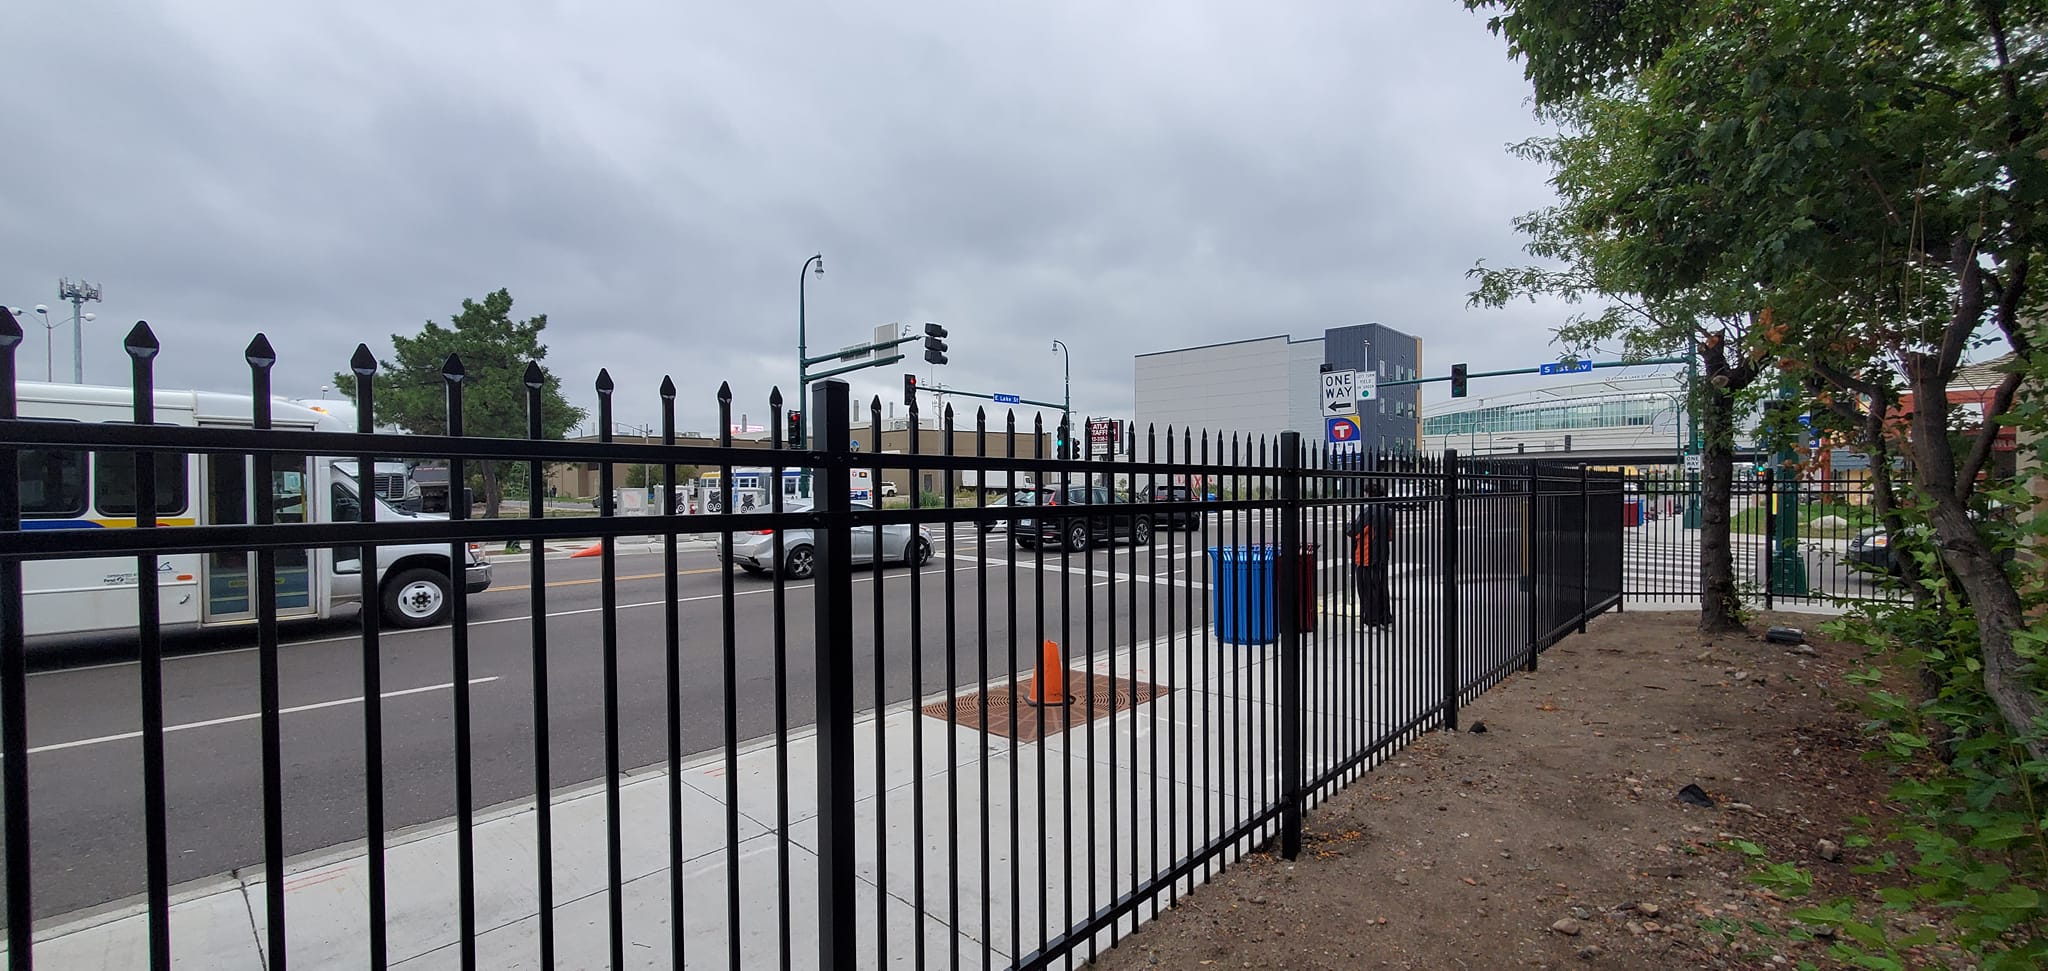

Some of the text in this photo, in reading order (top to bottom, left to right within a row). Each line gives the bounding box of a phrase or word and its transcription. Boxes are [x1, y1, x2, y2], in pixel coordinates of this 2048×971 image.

[1326, 374, 1351, 387] ONE
[1325, 386, 1352, 399] WAY
[1334, 425, 1349, 438] T
